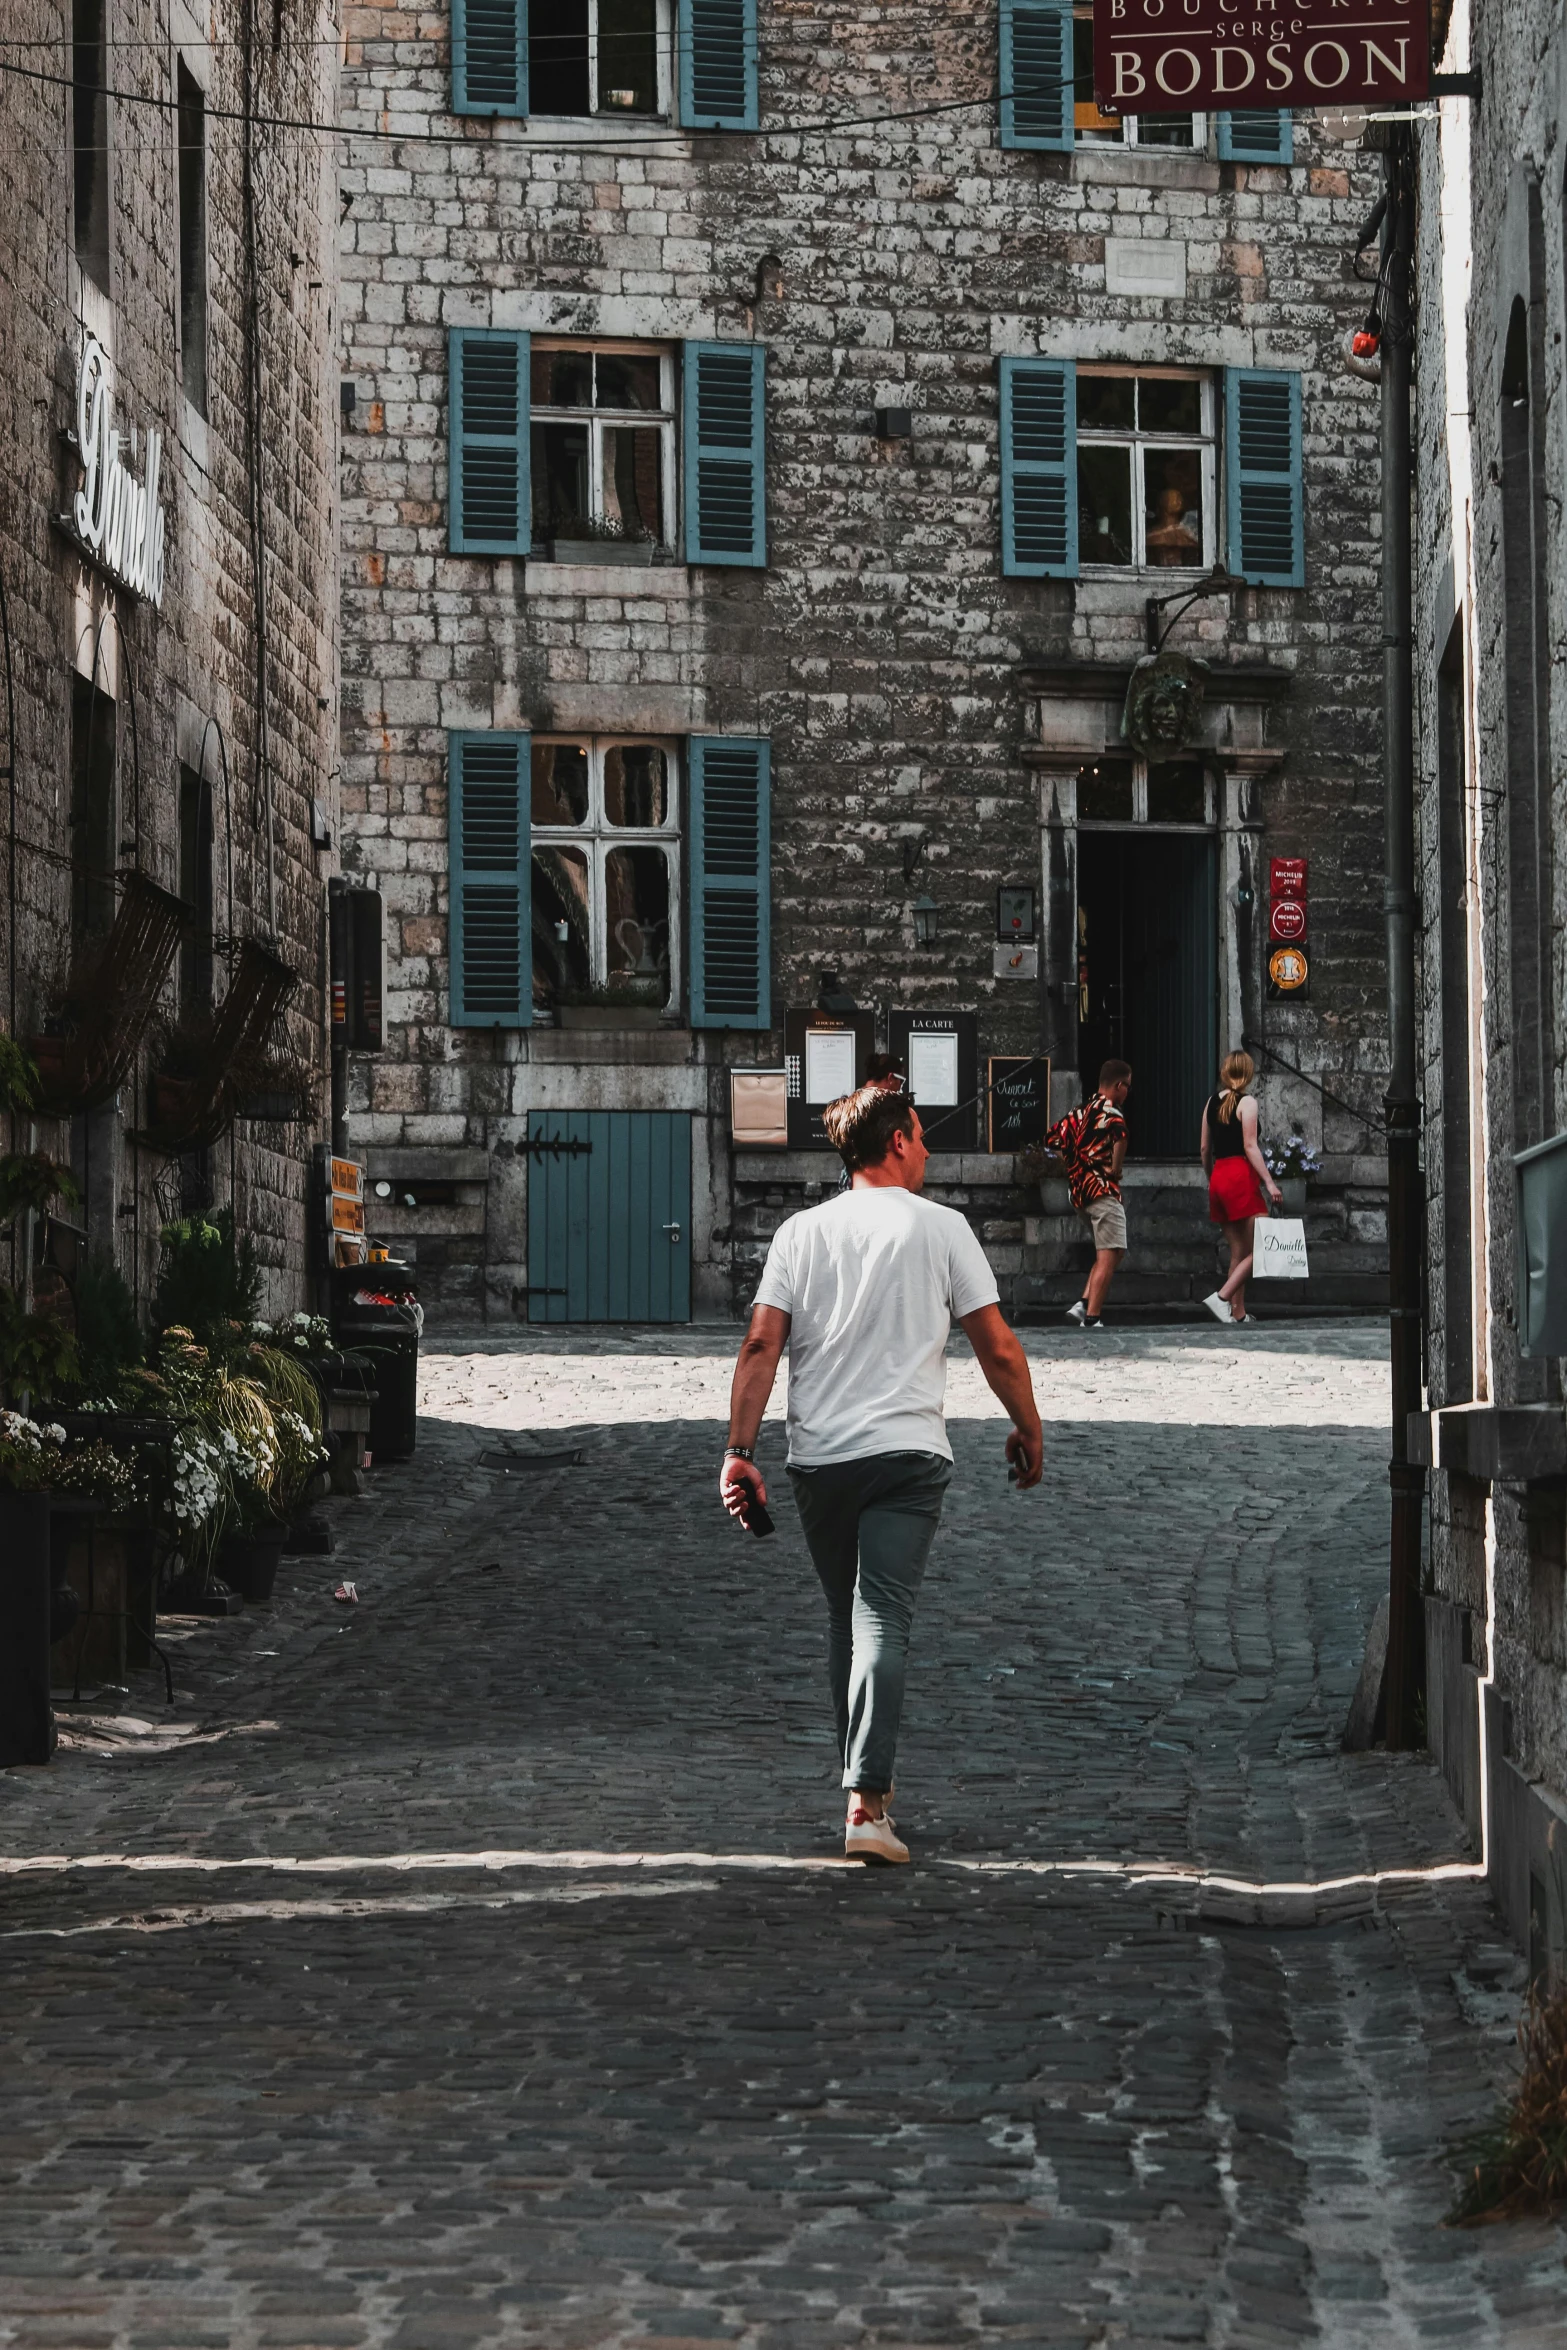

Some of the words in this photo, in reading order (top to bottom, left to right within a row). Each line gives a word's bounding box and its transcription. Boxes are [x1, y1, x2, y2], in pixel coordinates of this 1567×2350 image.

[1110, 38, 1410, 98] BODSON
[74, 340, 164, 610] Danielle
[912, 1019, 924, 1028] LA
[925, 1019, 954, 1029] CARTE
[1264, 1234, 1304, 1252] Danielle
